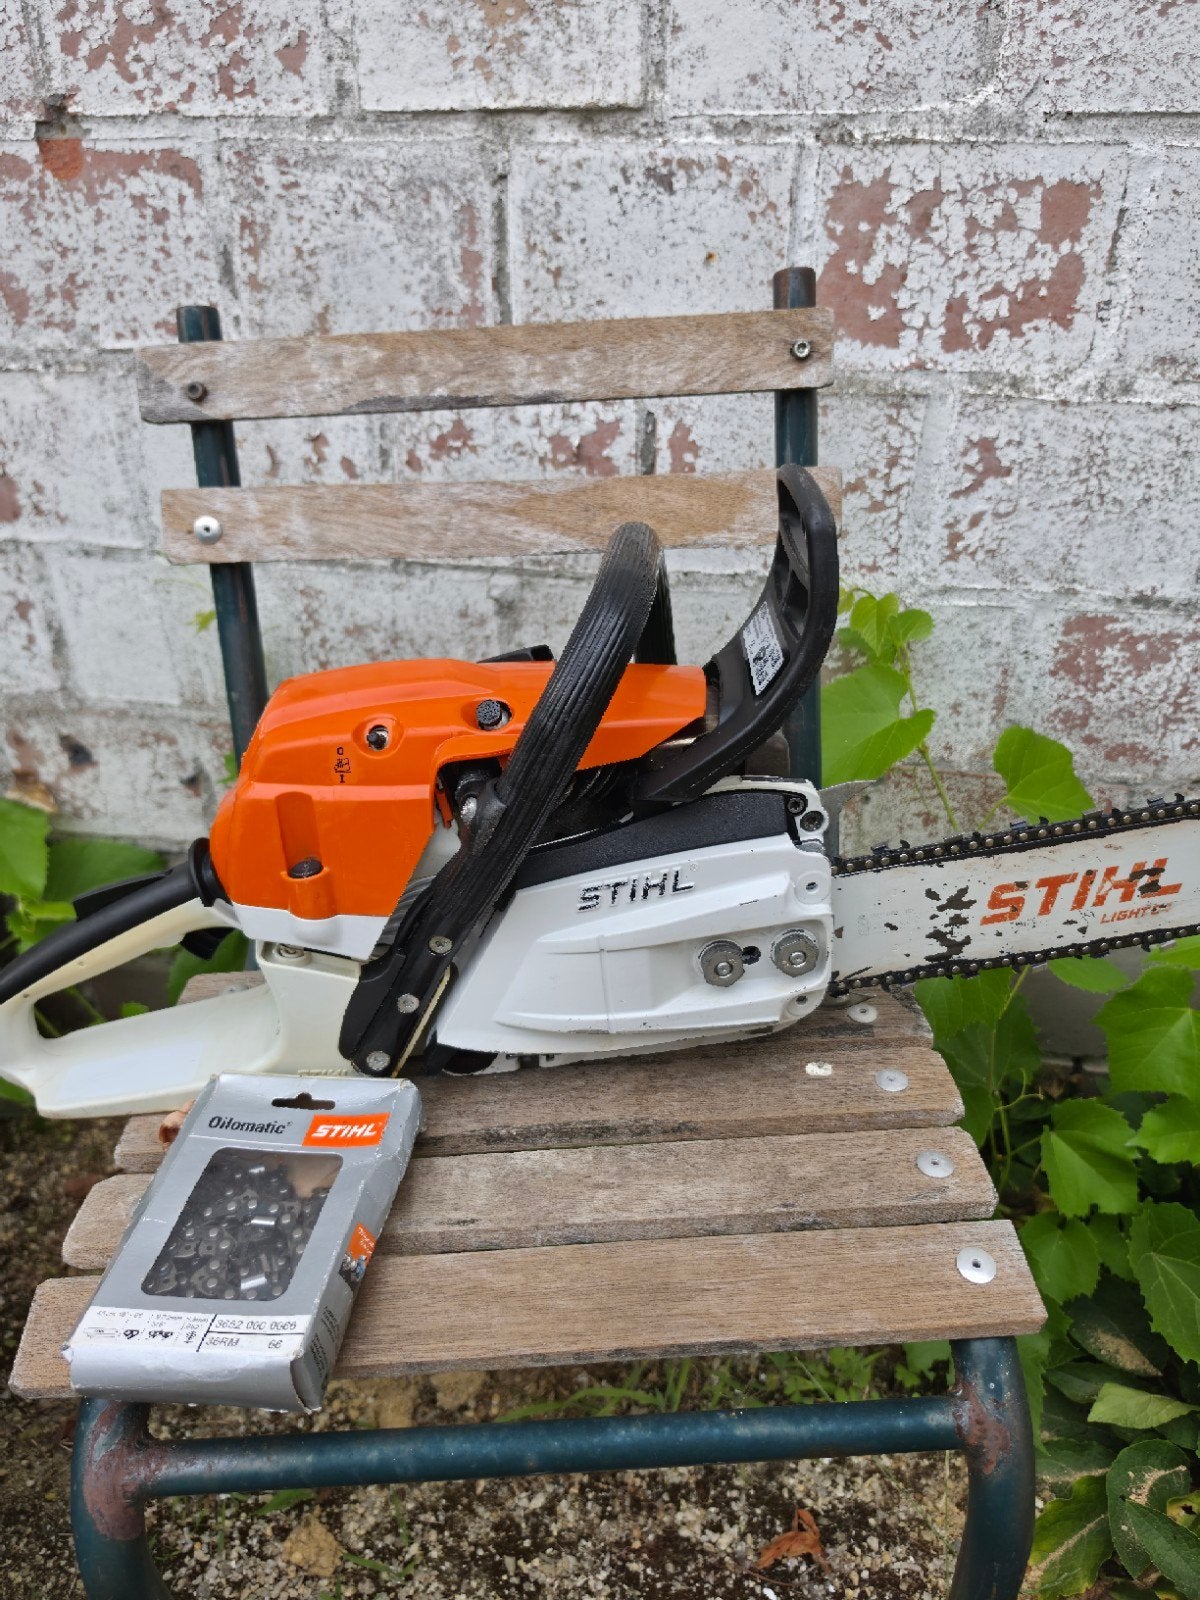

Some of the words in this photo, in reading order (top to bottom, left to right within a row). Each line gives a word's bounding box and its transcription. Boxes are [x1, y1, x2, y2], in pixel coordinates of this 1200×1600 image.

[577, 867, 695, 913] STIHL
[979, 857, 1183, 926] STIHL
[208, 1115, 287, 1135] Oilomatic
[311, 1122, 378, 1138] STIHL
